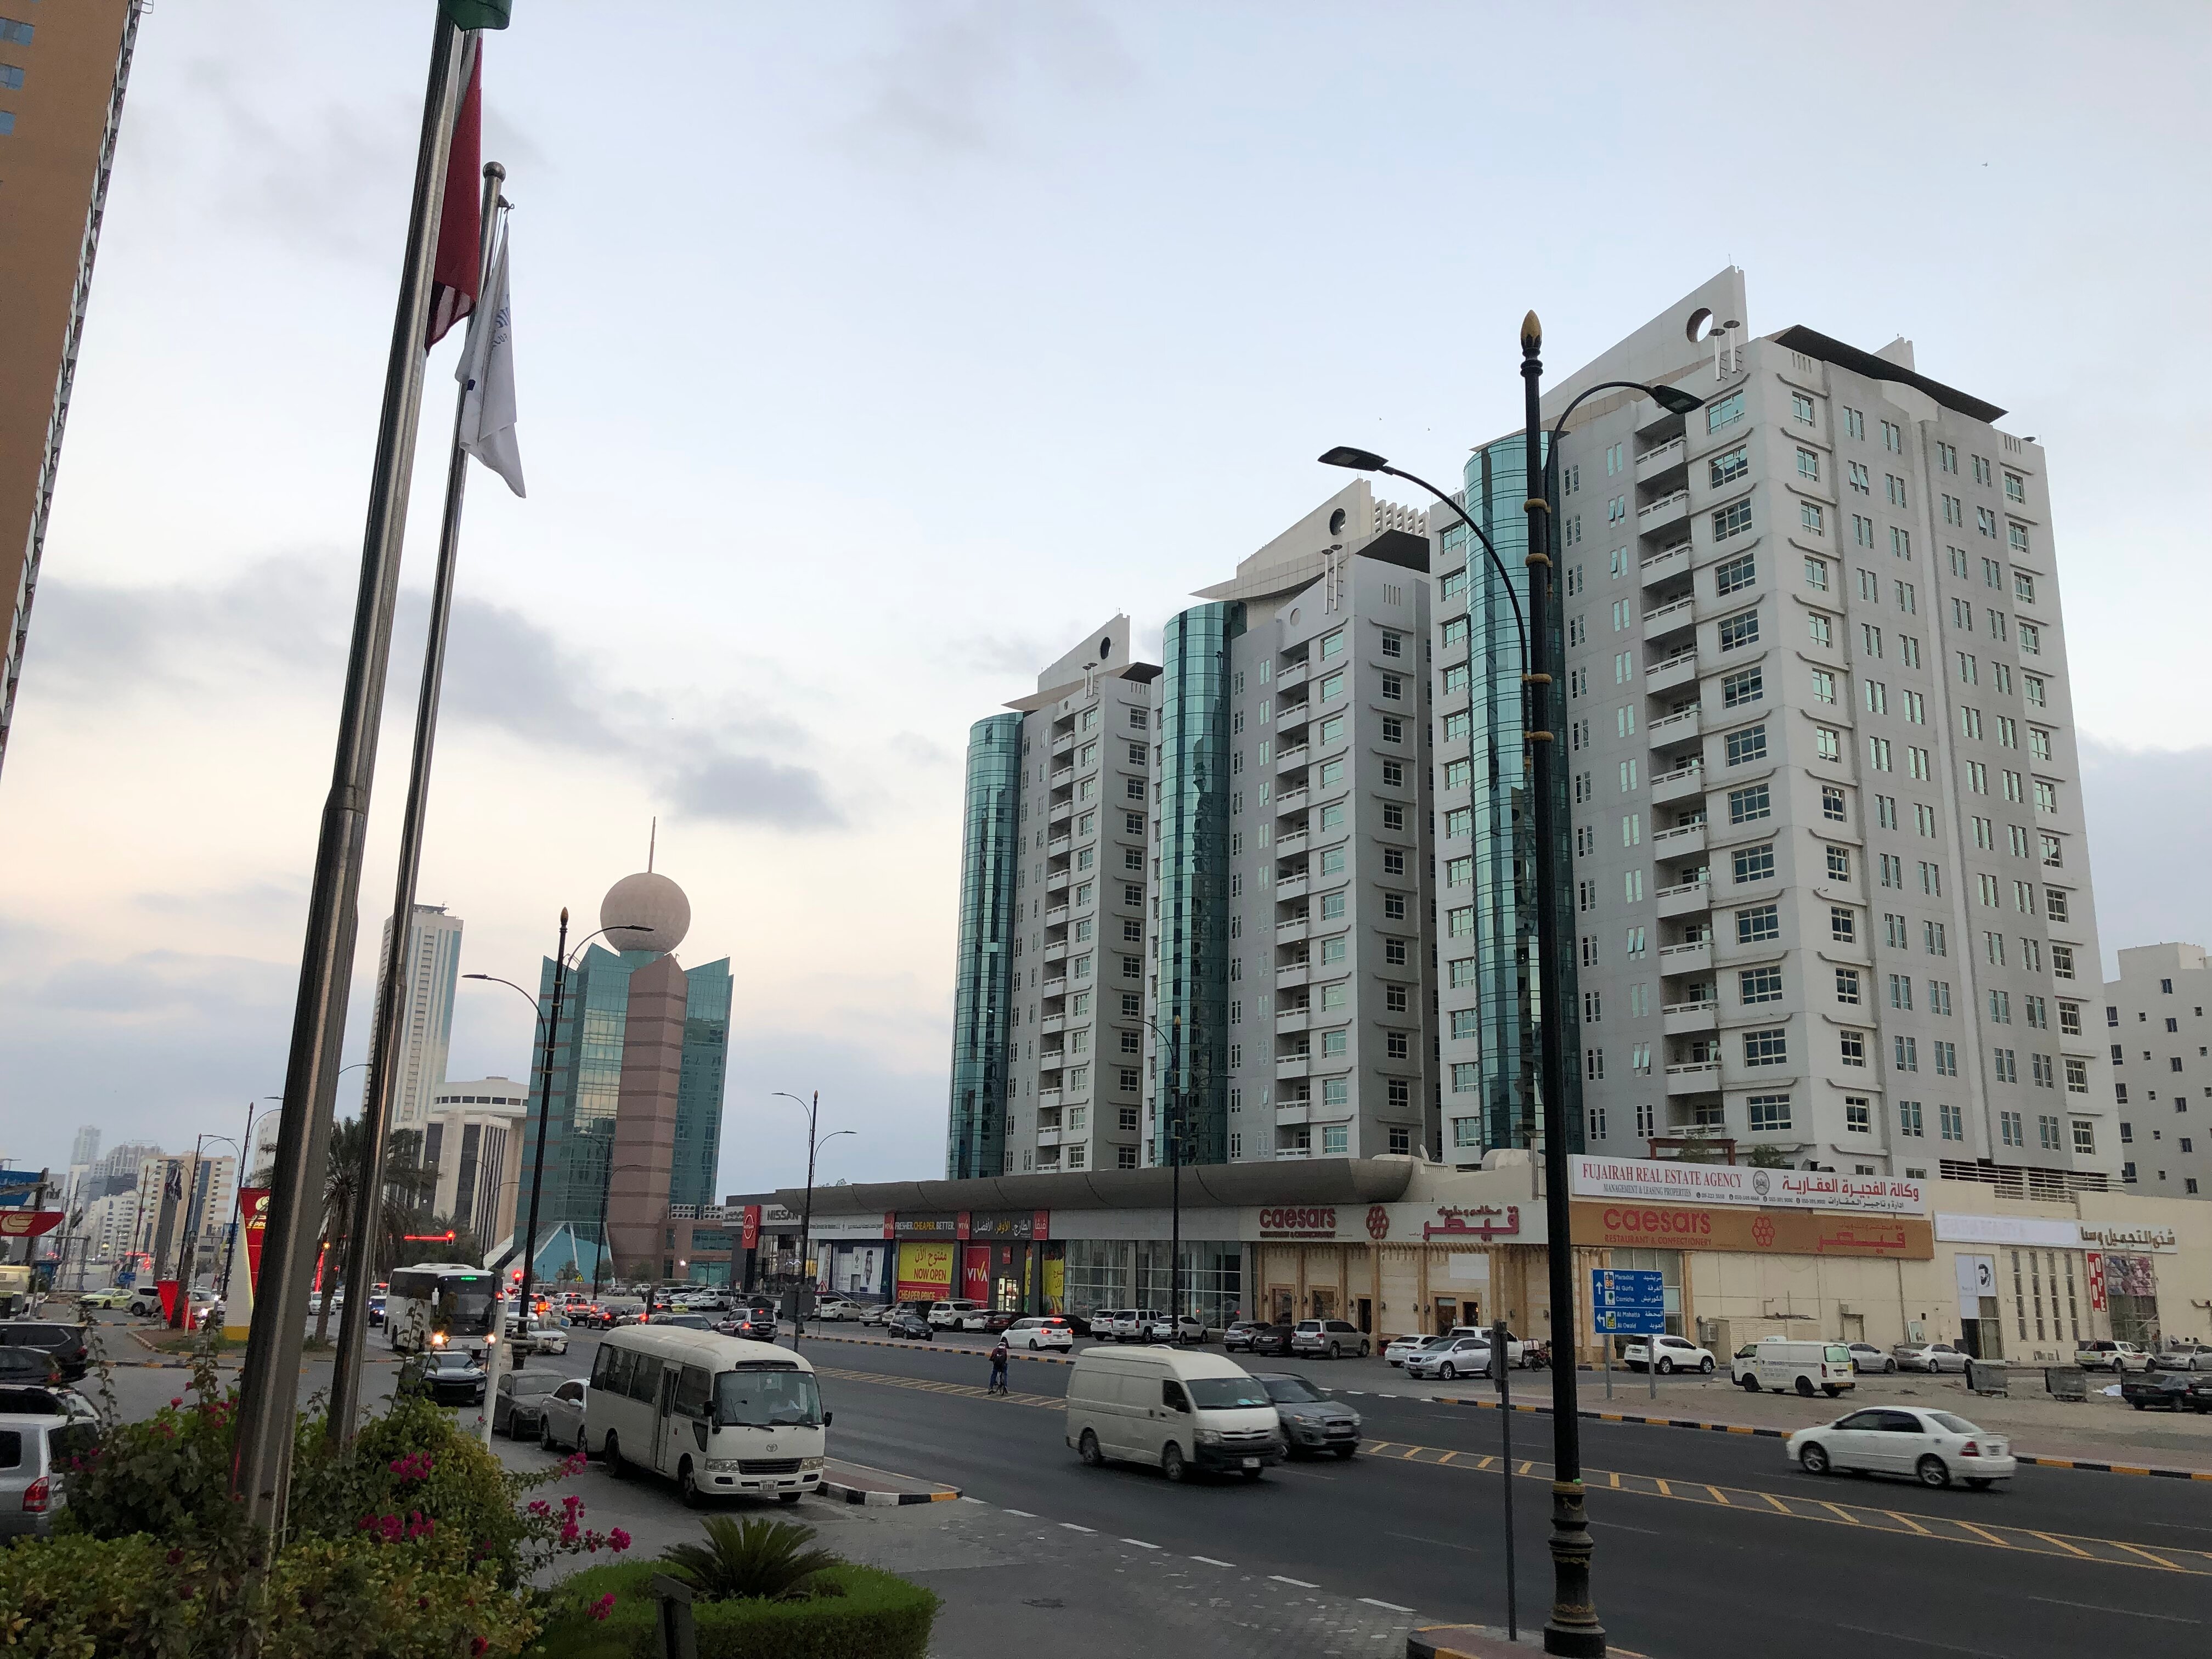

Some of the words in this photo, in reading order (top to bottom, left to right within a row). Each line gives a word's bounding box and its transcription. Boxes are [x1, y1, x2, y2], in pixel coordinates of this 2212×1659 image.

[1583, 1163, 1633, 1181] FUJAIRAH
[1637, 1167, 1662, 1183] REAL
[1665, 1169, 1701, 1186] ESTATE
[1704, 1172, 1742, 1188] AGENCY
[1782, 1175, 1838, 1195] العقارية
[1603, 1183, 1638, 1194] MANAGEMENT
[1644, 1187, 1663, 1195] LEASING
[1664, 1188, 1691, 1197] PROPERTIES
[1842, 1179, 1887, 1198] الفجيرة
[1891, 1182, 1919, 1201] وكالة
[767, 1209, 798, 1221] NISSAN
[958, 1220, 969, 1229] VIVA
[1260, 1209, 1336, 1229] caesars
[1603, 1209, 1711, 1234] caesars
[1604, 1234, 1648, 1244] RESTAURANT
[1658, 1238, 1712, 1246] CONFECTIONERY
[913, 1268, 929, 1280] NOW
[930, 1268, 946, 1281] OPEN
[967, 1261, 988, 1282] VIVA
[898, 1290, 920, 1300] CHEAPER
